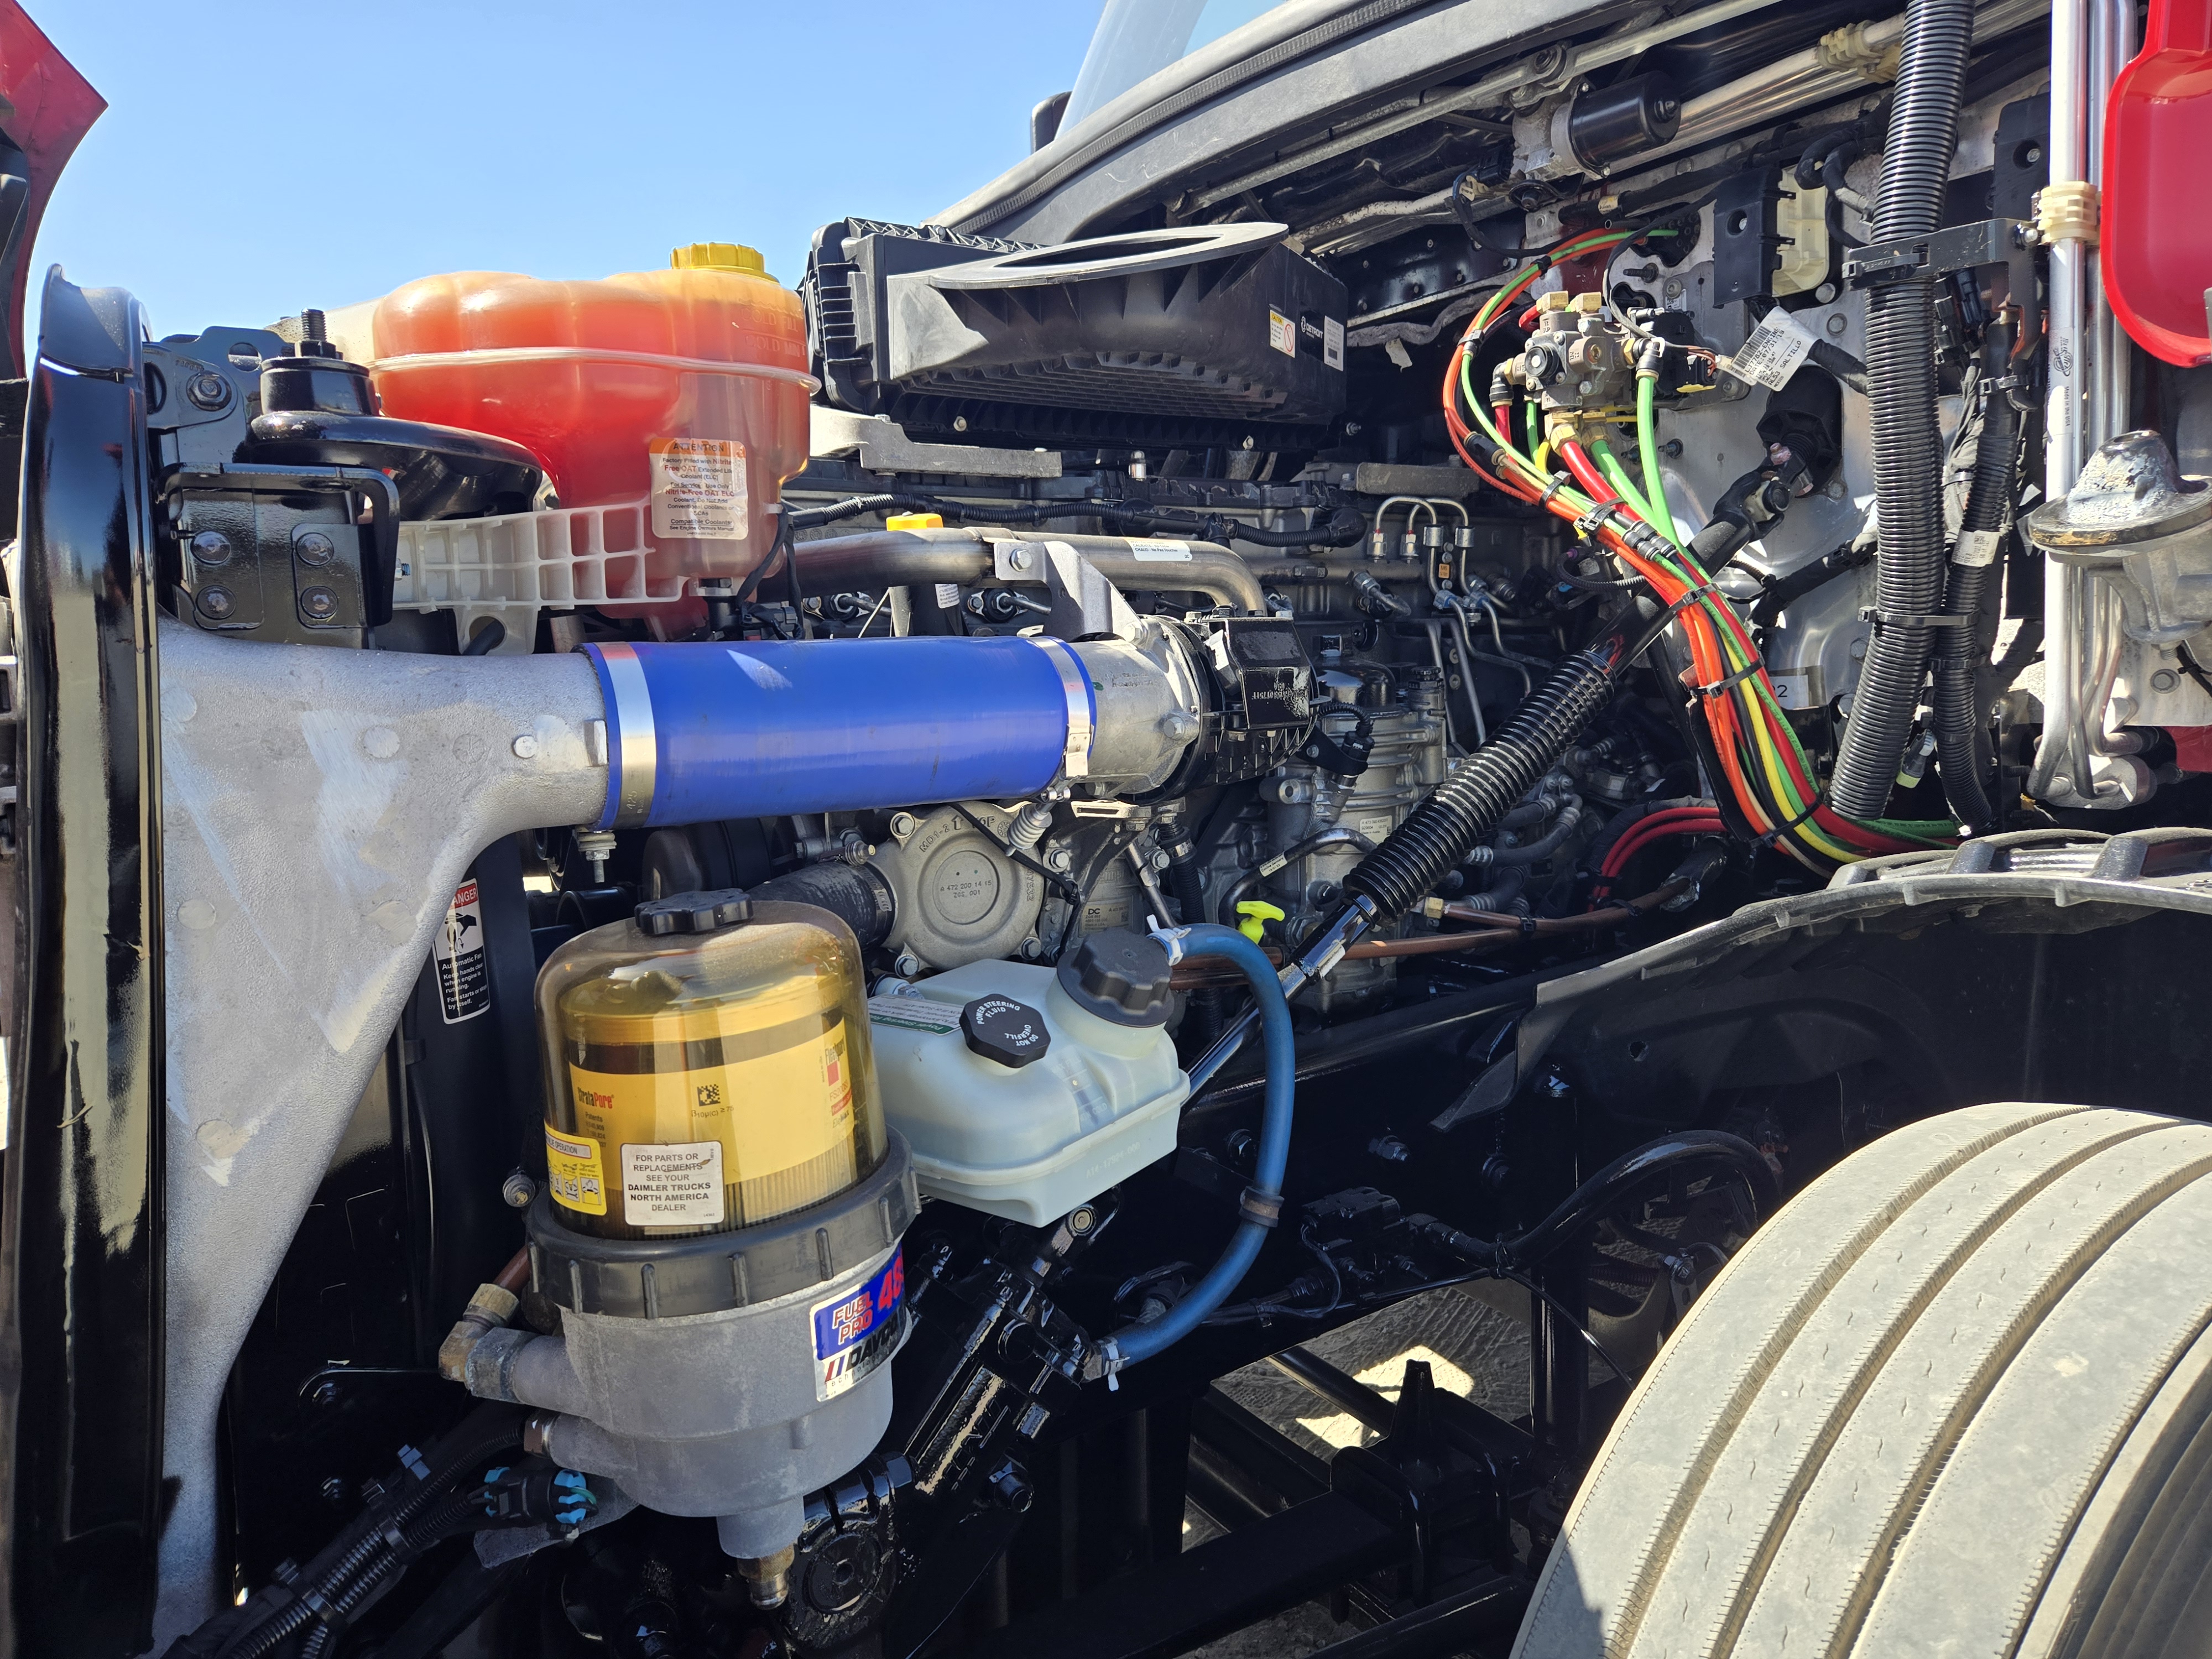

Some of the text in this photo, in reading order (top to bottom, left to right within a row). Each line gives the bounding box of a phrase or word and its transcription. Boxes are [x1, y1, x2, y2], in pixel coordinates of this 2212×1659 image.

[741, 307, 777, 326] COLD
[1306, 323, 1323, 338] DETROIT
[745, 335, 780, 352] COLD
[1767, 371, 1781, 385] AL53
[1780, 340, 1802, 369] SALTILLO
[673, 443, 724, 452] ATTENTION
[1773, 685, 1788, 698] 2
[919, 823, 951, 853] MD1-2
[454, 888, 477, 905] ANGER
[460, 967, 475, 975] hands
[461, 974, 477, 982] engine
[459, 990, 474, 1000] starts
[975, 1001, 1021, 1025] POWER STEERING
[985, 1006, 1006, 1018] FLUID
[883, 1016, 943, 1031] Power Steering
[1004, 1024, 1032, 1040] OVERFILL
[1029, 1034, 1039, 1042] DO
[555, 1140, 578, 1155] OPERATION
[655, 1154, 683, 1162] PARTS
[633, 1163, 703, 1172] REPLACEMENTS
[628, 1182, 711, 1192] DAIMLER TRUCKS
[664, 1193, 709, 1201] AMERICA
[832, 1291, 873, 1329] FUEL
[837, 1310, 873, 1345] PRO
